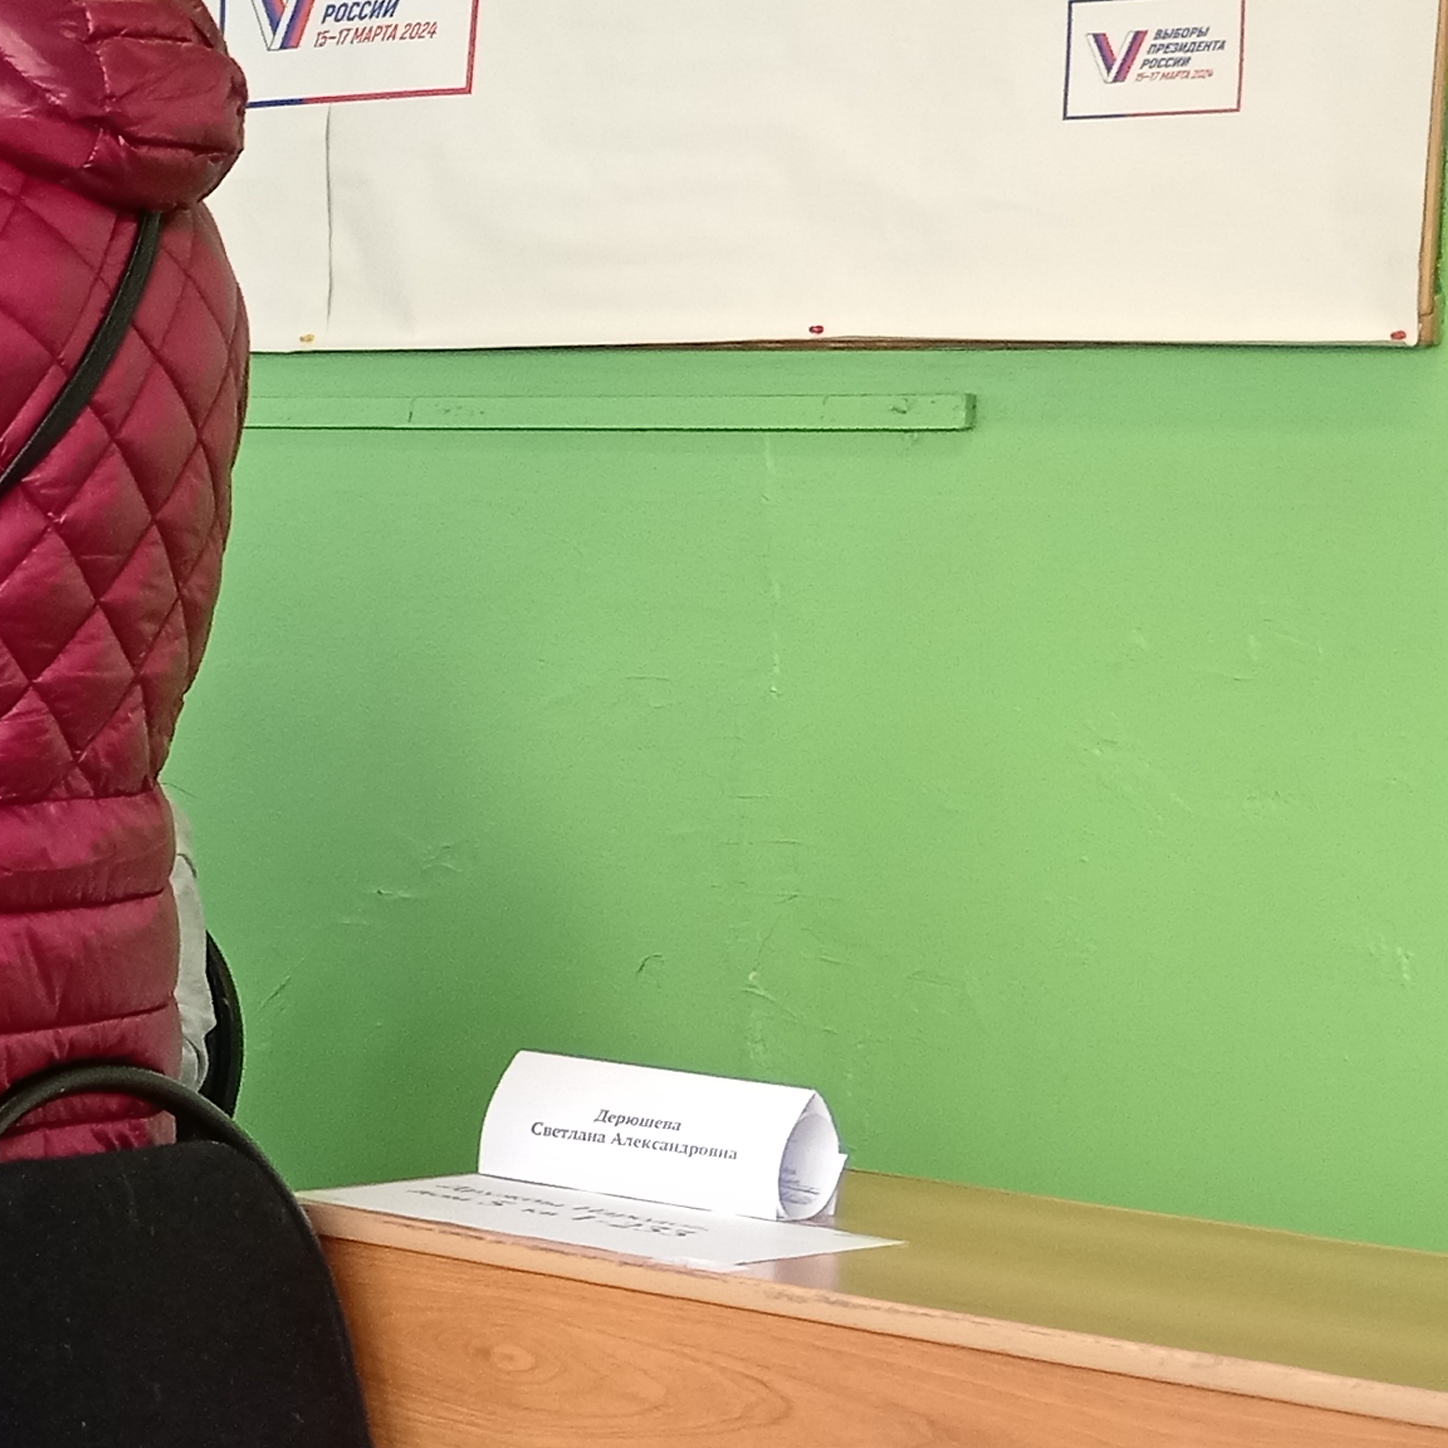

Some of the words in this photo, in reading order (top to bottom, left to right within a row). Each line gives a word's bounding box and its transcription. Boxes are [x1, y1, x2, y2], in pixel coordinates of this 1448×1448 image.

[350, 23, 399, 45] МАРТА
[399, 21, 438, 41] 2024
[1153, 26, 1210, 40] ВЫБОРЫ
[1146, 39, 1226, 55] ПРЕЗИДЕНТА
[1140, 56, 1192, 69] РОССИИ
[593, 1108, 682, 1131] Дерюшева
[531, 1121, 606, 1144] Светлана
[610, 1132, 738, 1160] Александровна
